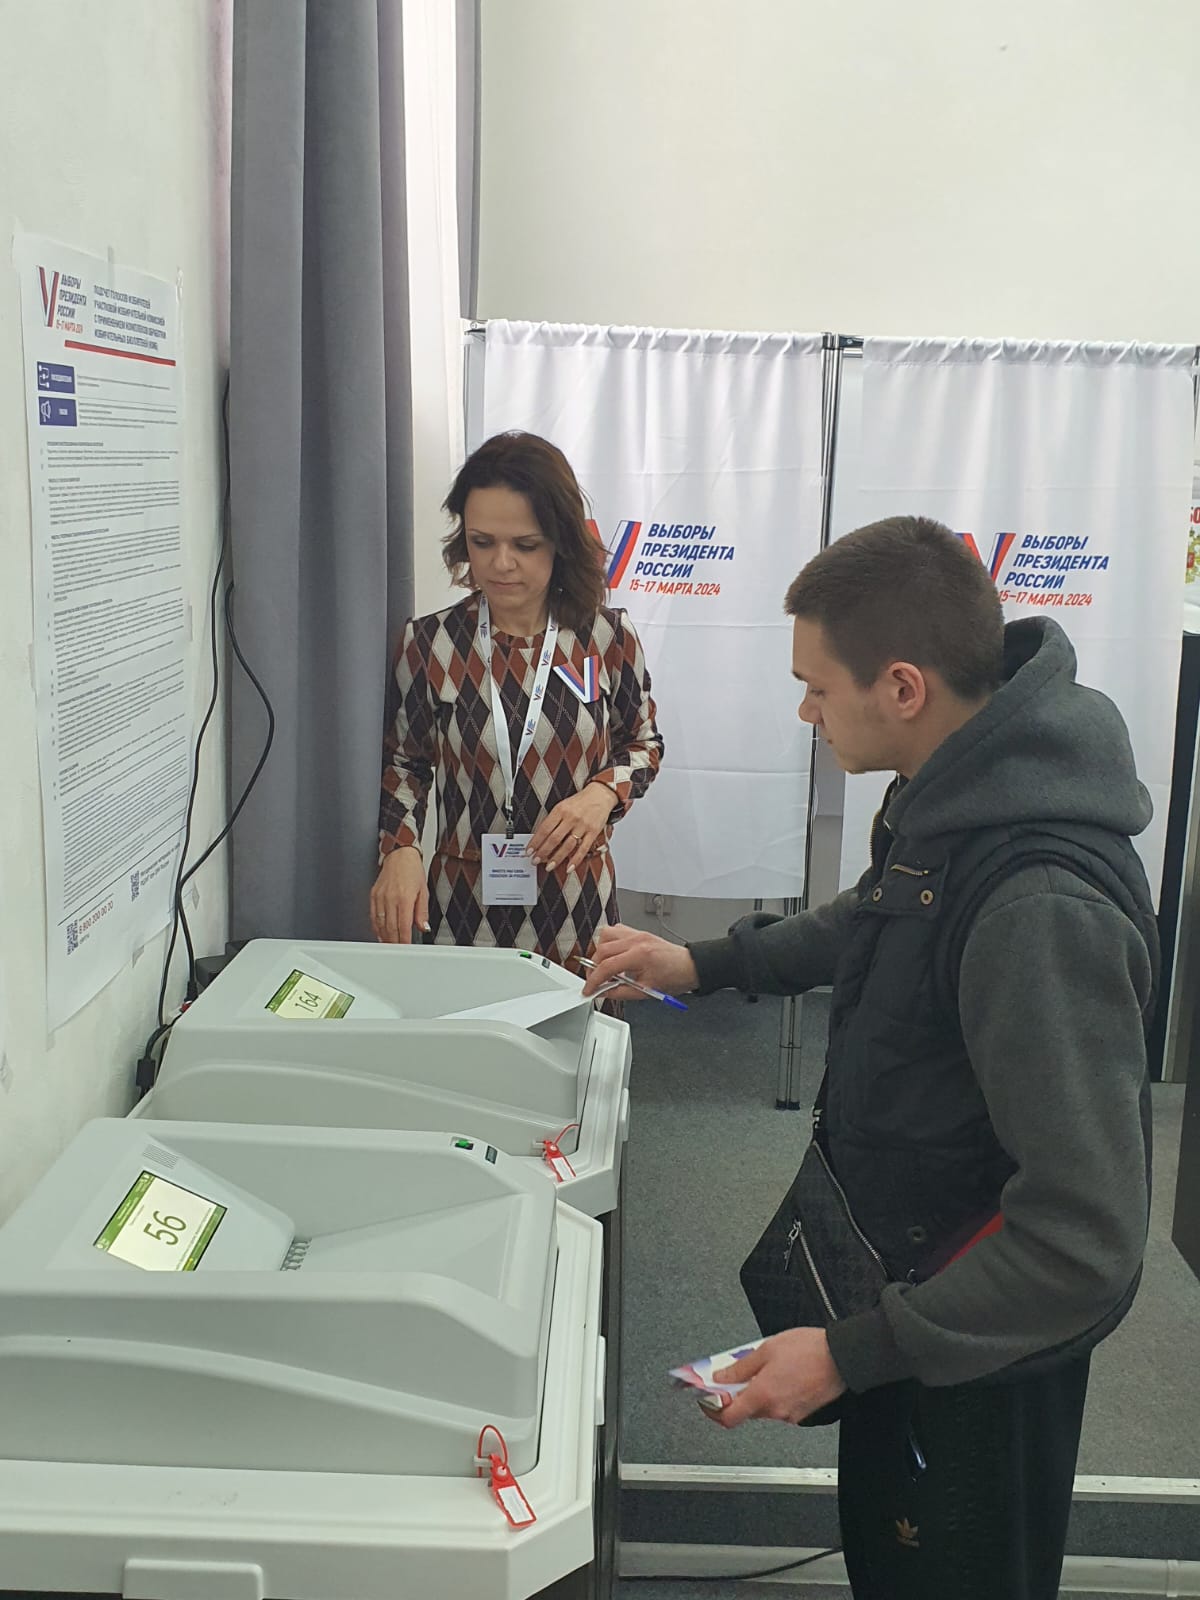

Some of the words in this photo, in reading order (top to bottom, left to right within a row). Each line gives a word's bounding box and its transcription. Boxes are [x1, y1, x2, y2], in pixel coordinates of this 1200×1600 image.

[648, 523, 716, 540] ВЫБОРЫ
[1021, 534, 1089, 550] ВЫБОРЫ
[640, 542, 735, 561] ПРЕЗИДЕНТА
[634, 561, 694, 578] РОССИИ
[1013, 553, 1110, 572] ПРЕЗИДЕНТА
[1003, 571, 1066, 589] РОССИИ
[656, 582, 692, 595] МАРТА
[693, 583, 720, 596] 2024
[1027, 593, 1064, 606] МАРТА
[1064, 593, 1093, 606] 2024
[294, 990, 323, 1013] 164
[143, 1210, 187, 1246] 56
